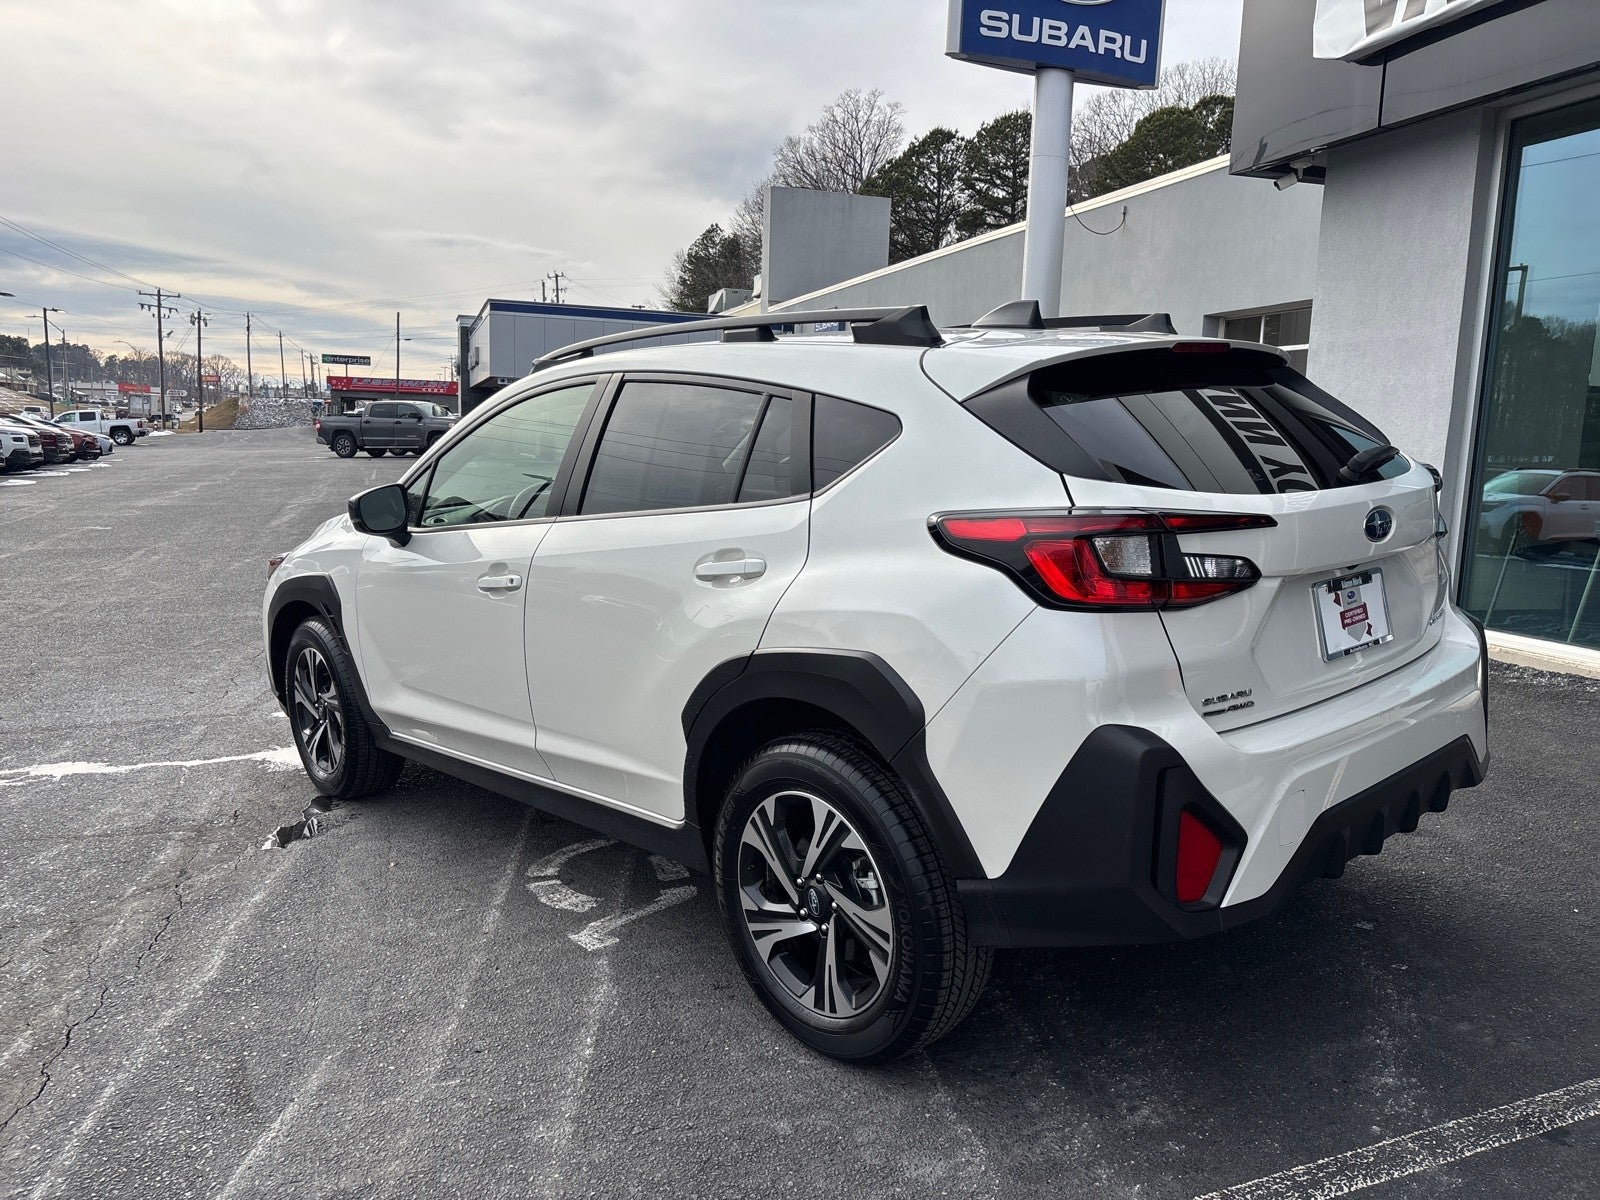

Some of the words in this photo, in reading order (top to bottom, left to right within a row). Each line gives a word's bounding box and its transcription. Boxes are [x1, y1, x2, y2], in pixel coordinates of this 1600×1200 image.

[979, 9, 1148, 65] SUBARU
[323, 355, 370, 365] enterprise
[1344, 607, 1364, 618] CERTIFIED
[1343, 613, 1366, 625] PRE-OWNED
[1201, 688, 1252, 706] SUBARU
[1226, 700, 1255, 712] AWD
[894, 899, 915, 1003] YOKOHAMA
